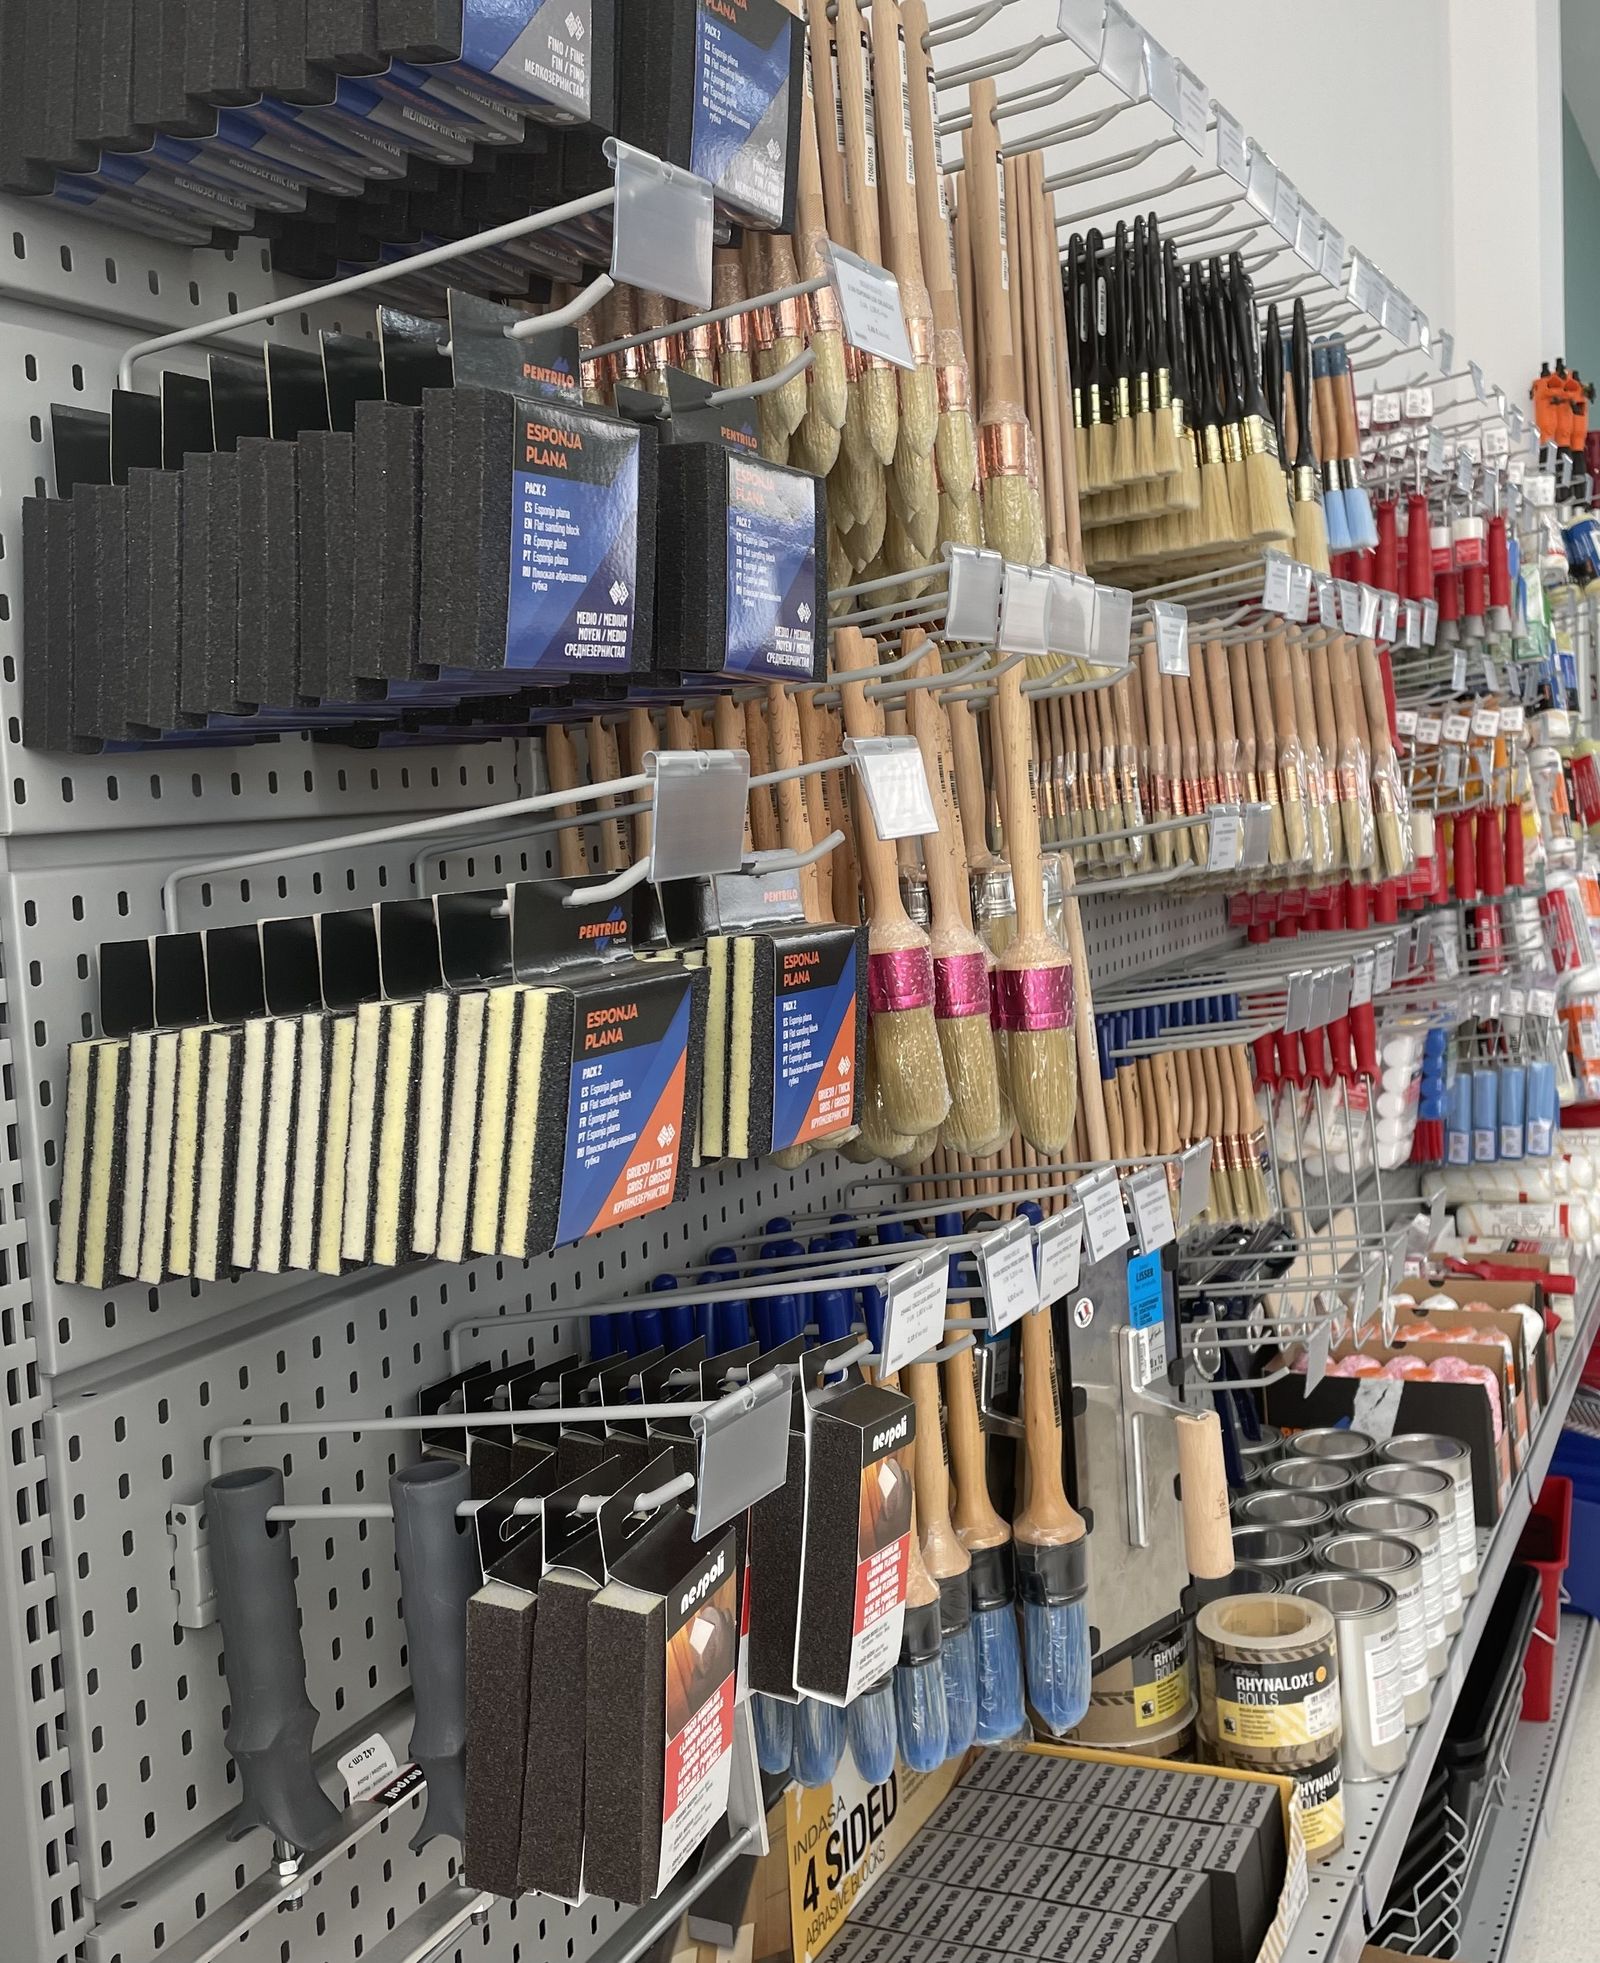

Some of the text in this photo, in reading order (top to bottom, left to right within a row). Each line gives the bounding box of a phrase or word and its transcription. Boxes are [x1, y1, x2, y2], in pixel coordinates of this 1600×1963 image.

[548, 36, 564, 56] FINO
[570, 47, 584, 66] FINE
[524, 58, 584, 100] МЕЛКОЗЕРНИСТАЯ
[552, 54, 562, 72] FIN
[570, 64, 584, 84] FINO
[523, 362, 574, 389] PENTRILO
[526, 422, 582, 450] ESPONJA
[720, 426, 758, 449] PENTRILO
[526, 446, 568, 470] PLANA
[524, 482, 541, 496] PACK
[524, 502, 570, 520] ES Esponja plana
[524, 518, 580, 537] EN Flat sanding block
[524, 534, 532, 546] FR
[522, 550, 569, 566] PT Esponja plana
[576, 611, 598, 626] MEDIO
[602, 613, 628, 628] MEDIUM
[578, 628, 601, 642] MOYEN
[606, 629, 626, 643] MEDIO
[564, 644, 626, 659] СРЕДНЕЗЕРНИСТАЯ
[764, 888, 798, 904] PENTRILO
[578, 920, 627, 940] PENTRILO
[784, 951, 820, 970] ESPONJA
[784, 970, 810, 988] PLANA
[586, 1004, 638, 1029] ESPONJA
[782, 1001, 794, 1012] PACK
[584, 1028, 624, 1050] PLANA
[582, 1065, 598, 1080] PACK
[580, 1078, 624, 1098] ES Esponja plana
[580, 1101, 588, 1114] EN
[589, 1098, 599, 1111] Flat
[599, 1094, 618, 1108] sanding
[579, 1116, 586, 1128] FR
[607, 1108, 620, 1122] plate
[578, 1122, 620, 1144] PT Esponja plana
[626, 1161, 650, 1180] GRUESO
[655, 1153, 674, 1171] THICK
[626, 1178, 643, 1195] GROS
[648, 1168, 672, 1187] GROSSO
[872, 1414, 907, 1452] nespoli
[680, 1550, 725, 1614] nespoli
[1236, 1673, 1309, 1692] RHYNALOX
[1237, 1692, 1280, 1706] ROLLS
[384, 1769, 422, 1799] nespoli
[1301, 1764, 1340, 1797] HYNALO
[1302, 1790, 1328, 1810] OLLS
[794, 1796, 846, 1866] INDASA
[802, 1769, 898, 1912] 4 SIDED
[806, 1840, 886, 1951] ABRASIVE BLOCKS
[1090, 1876, 1119, 1906] INDASA
[1122, 1881, 1152, 1912] INDASA
[1156, 1886, 1188, 1918] INDASA
[858, 1890, 892, 1922] INDASA
[890, 1896, 922, 1928] INDASA
[921, 1904, 953, 1936] INDASA
[954, 1909, 986, 1941] INDASA
[986, 1914, 1018, 1946] INDASA
[1019, 1920, 1050, 1952] INDASA
[1054, 1926, 1084, 1959] INDASA
